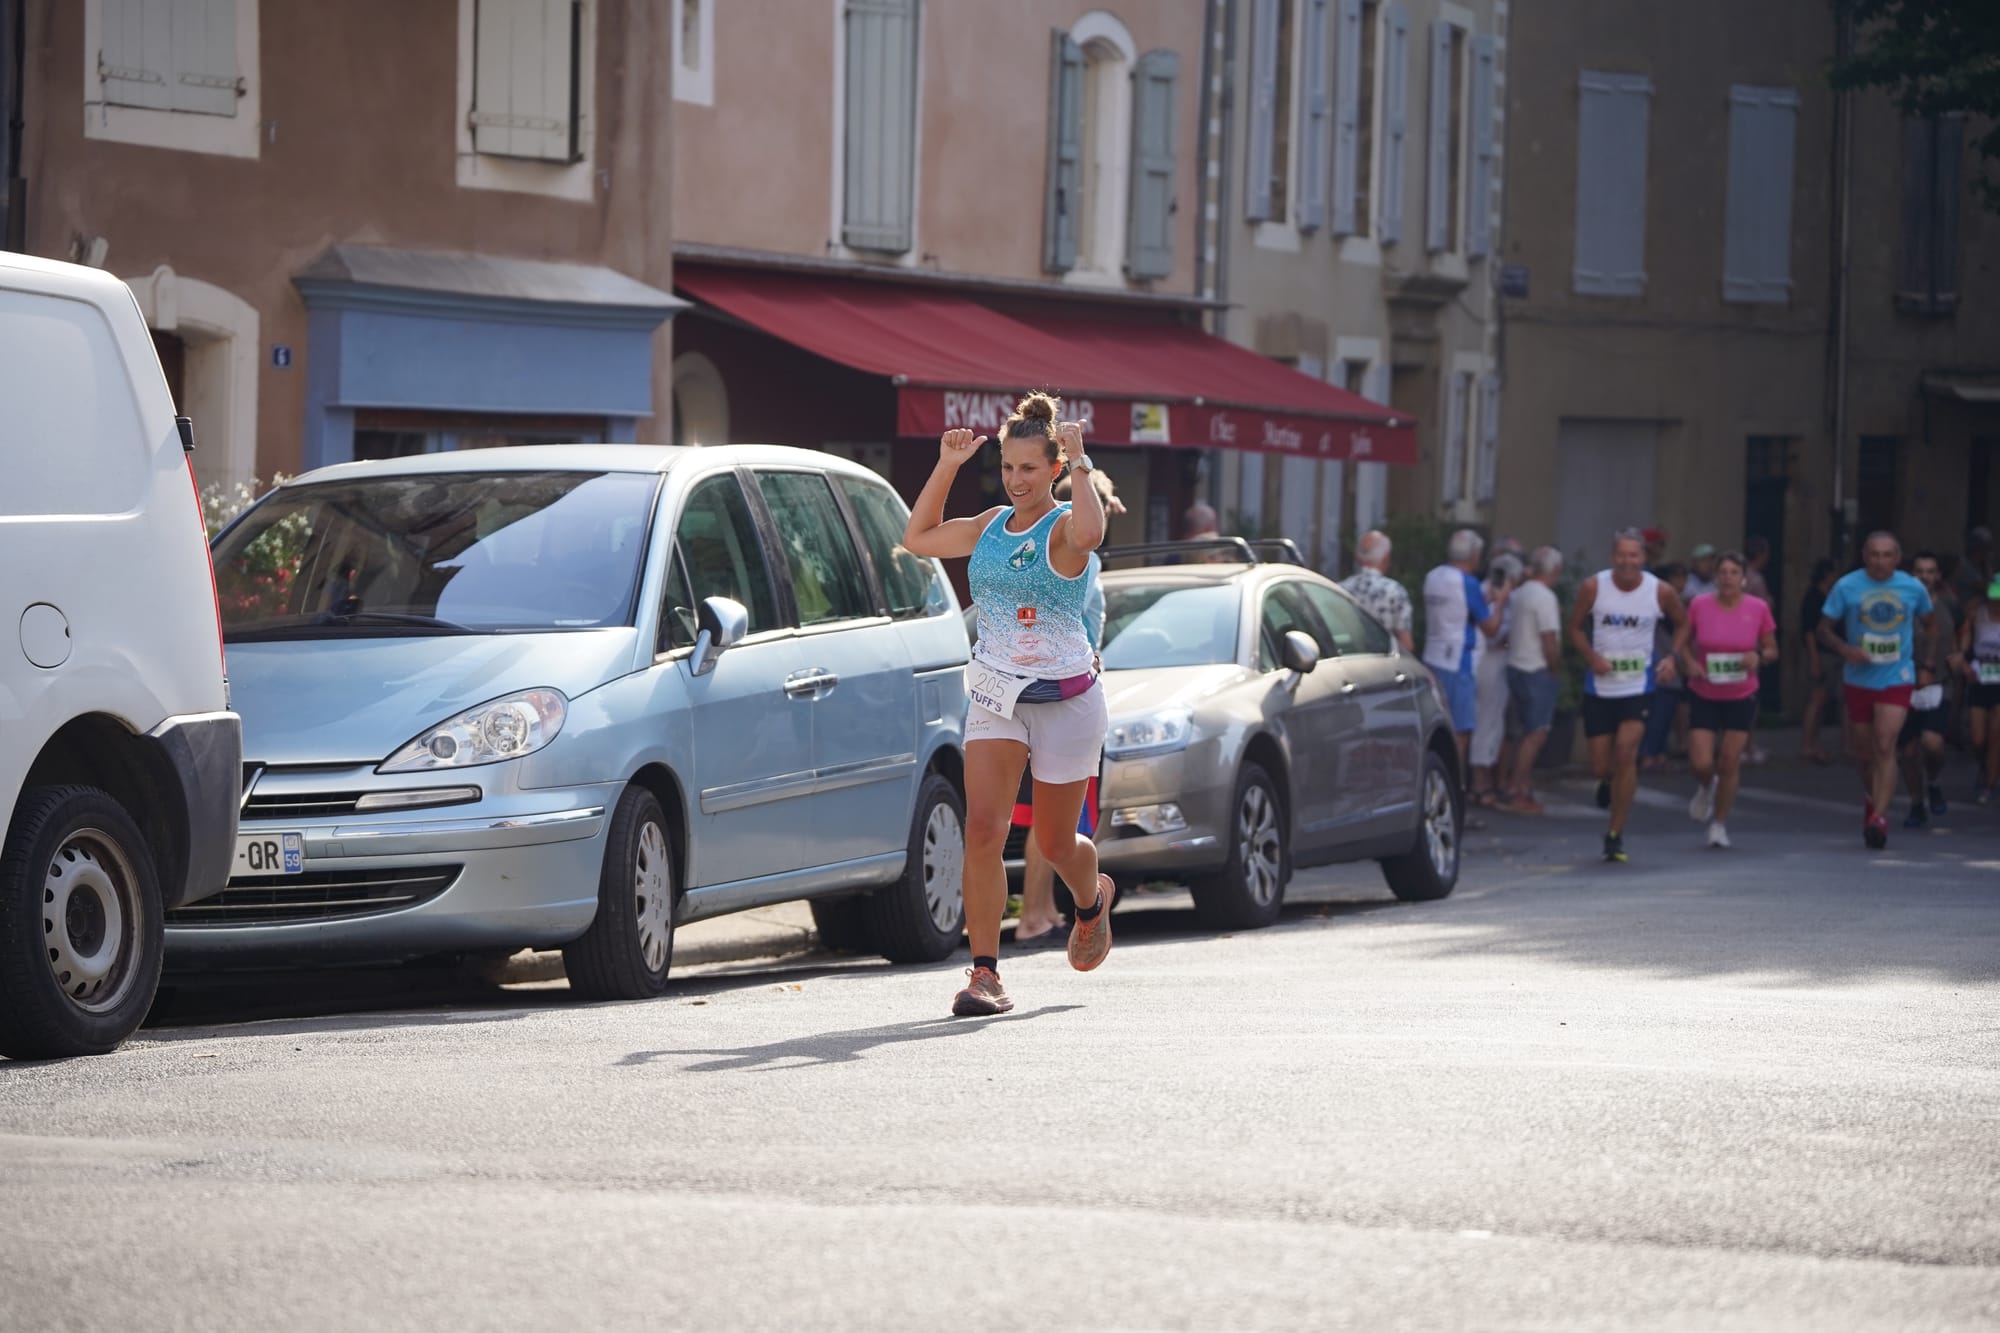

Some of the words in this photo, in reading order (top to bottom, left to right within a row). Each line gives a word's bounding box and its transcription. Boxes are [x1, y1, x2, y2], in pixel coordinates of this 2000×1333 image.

[944, 391, 1014, 428] RYAN'S
[974, 672, 1010, 698] 205
[970, 689, 1003, 712] TUFF'S
[285, 853, 300, 868] 59
